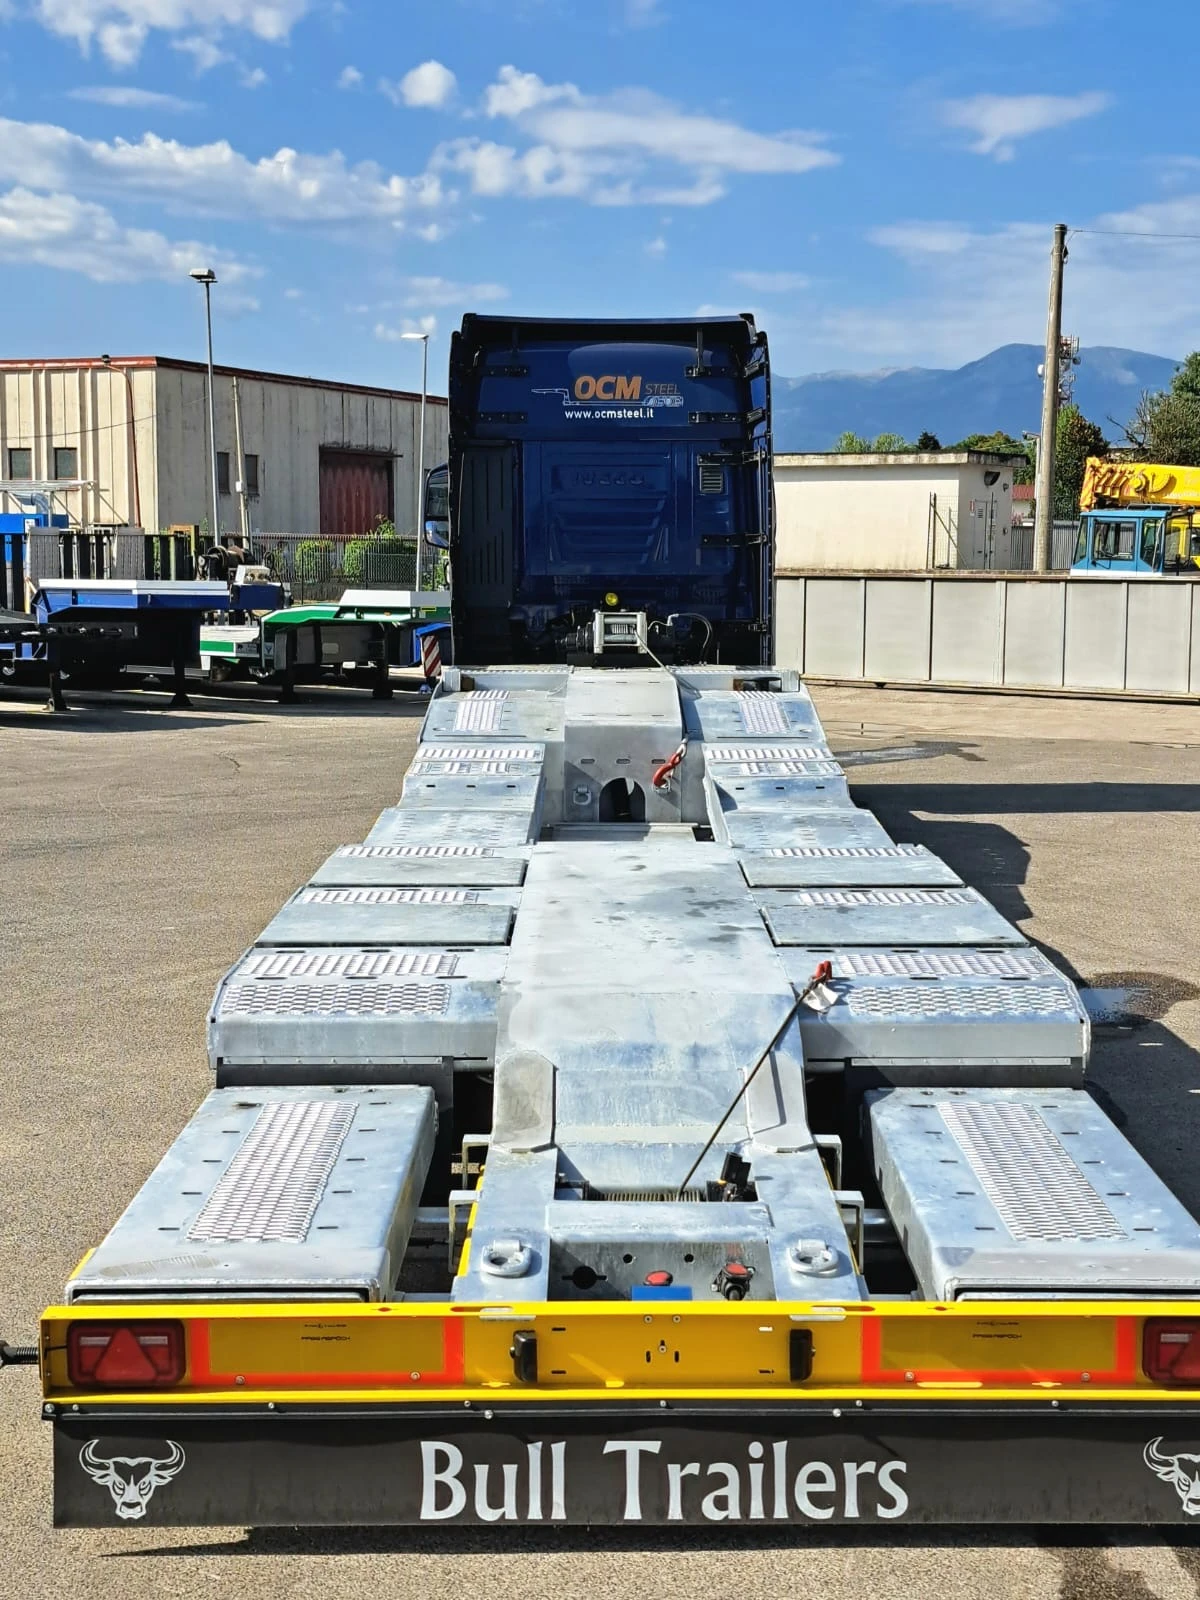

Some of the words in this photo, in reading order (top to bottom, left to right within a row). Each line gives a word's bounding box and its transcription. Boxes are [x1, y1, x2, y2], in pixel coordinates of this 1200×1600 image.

[575, 375, 642, 400] OCM
[645, 383, 681, 395] STEEL
[565, 408, 654, 419] www.ocmsteel.it
[420, 1441, 567, 1521] Bull
[603, 1441, 909, 1521] Trailers
